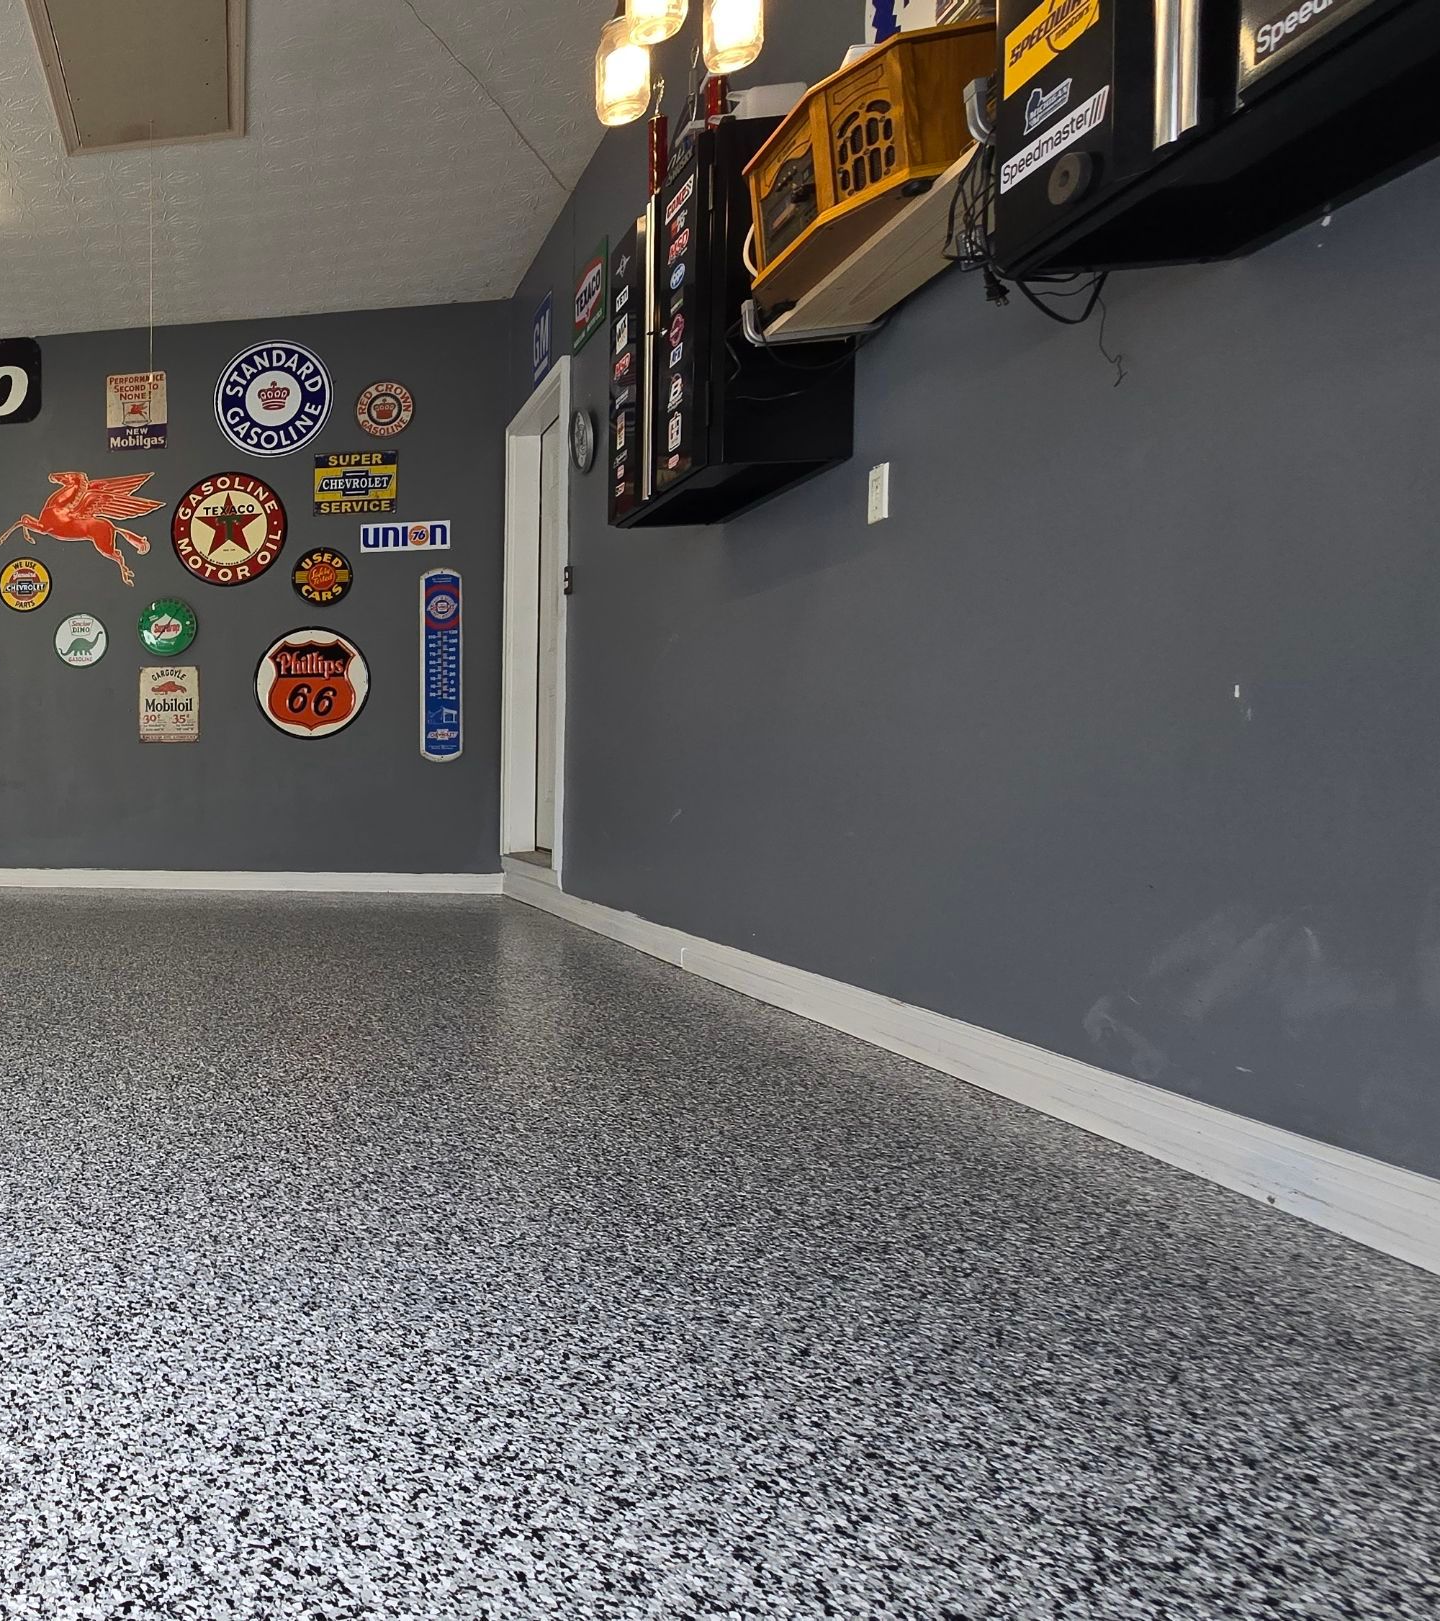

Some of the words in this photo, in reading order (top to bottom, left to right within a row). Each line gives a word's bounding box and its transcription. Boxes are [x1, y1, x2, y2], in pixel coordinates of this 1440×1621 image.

[1003, 107, 1090, 184] Speedmaster
[575, 269, 600, 317] TEXACO
[533, 308, 550, 368] GM
[225, 349, 322, 397] STANDARD
[114, 384, 145, 393] SECOND
[148, 382, 159, 390] TO
[358, 391, 372, 415] RED
[375, 384, 411, 412] CROWN
[126, 427, 148, 436] NEW
[226, 402, 322, 449] GASOLINE
[361, 417, 407, 435] GASOLINE
[110, 435, 164, 449] Mobilgas
[328, 453, 382, 466] SUPER
[322, 477, 388, 490] CHEVROLET
[178, 477, 279, 520] GASOLINE
[320, 500, 391, 513] SERVICE
[203, 504, 254, 516] TEXACO
[412, 531, 426, 541] 76
[178, 538, 250, 581] MOTOR
[256, 530, 282, 565] OIL
[301, 552, 343, 570] USED
[12, 561, 23, 570] WE
[24, 561, 37, 570] USE
[6, 584, 44, 592] CHEVROLET
[301, 584, 343, 601] CARS
[14, 600, 36, 609] PARTS
[276, 651, 344, 680] Phillips
[151, 669, 187, 681] GARGOYLE
[145, 697, 193, 712] Mobiloil
[286, 683, 338, 717] 66
